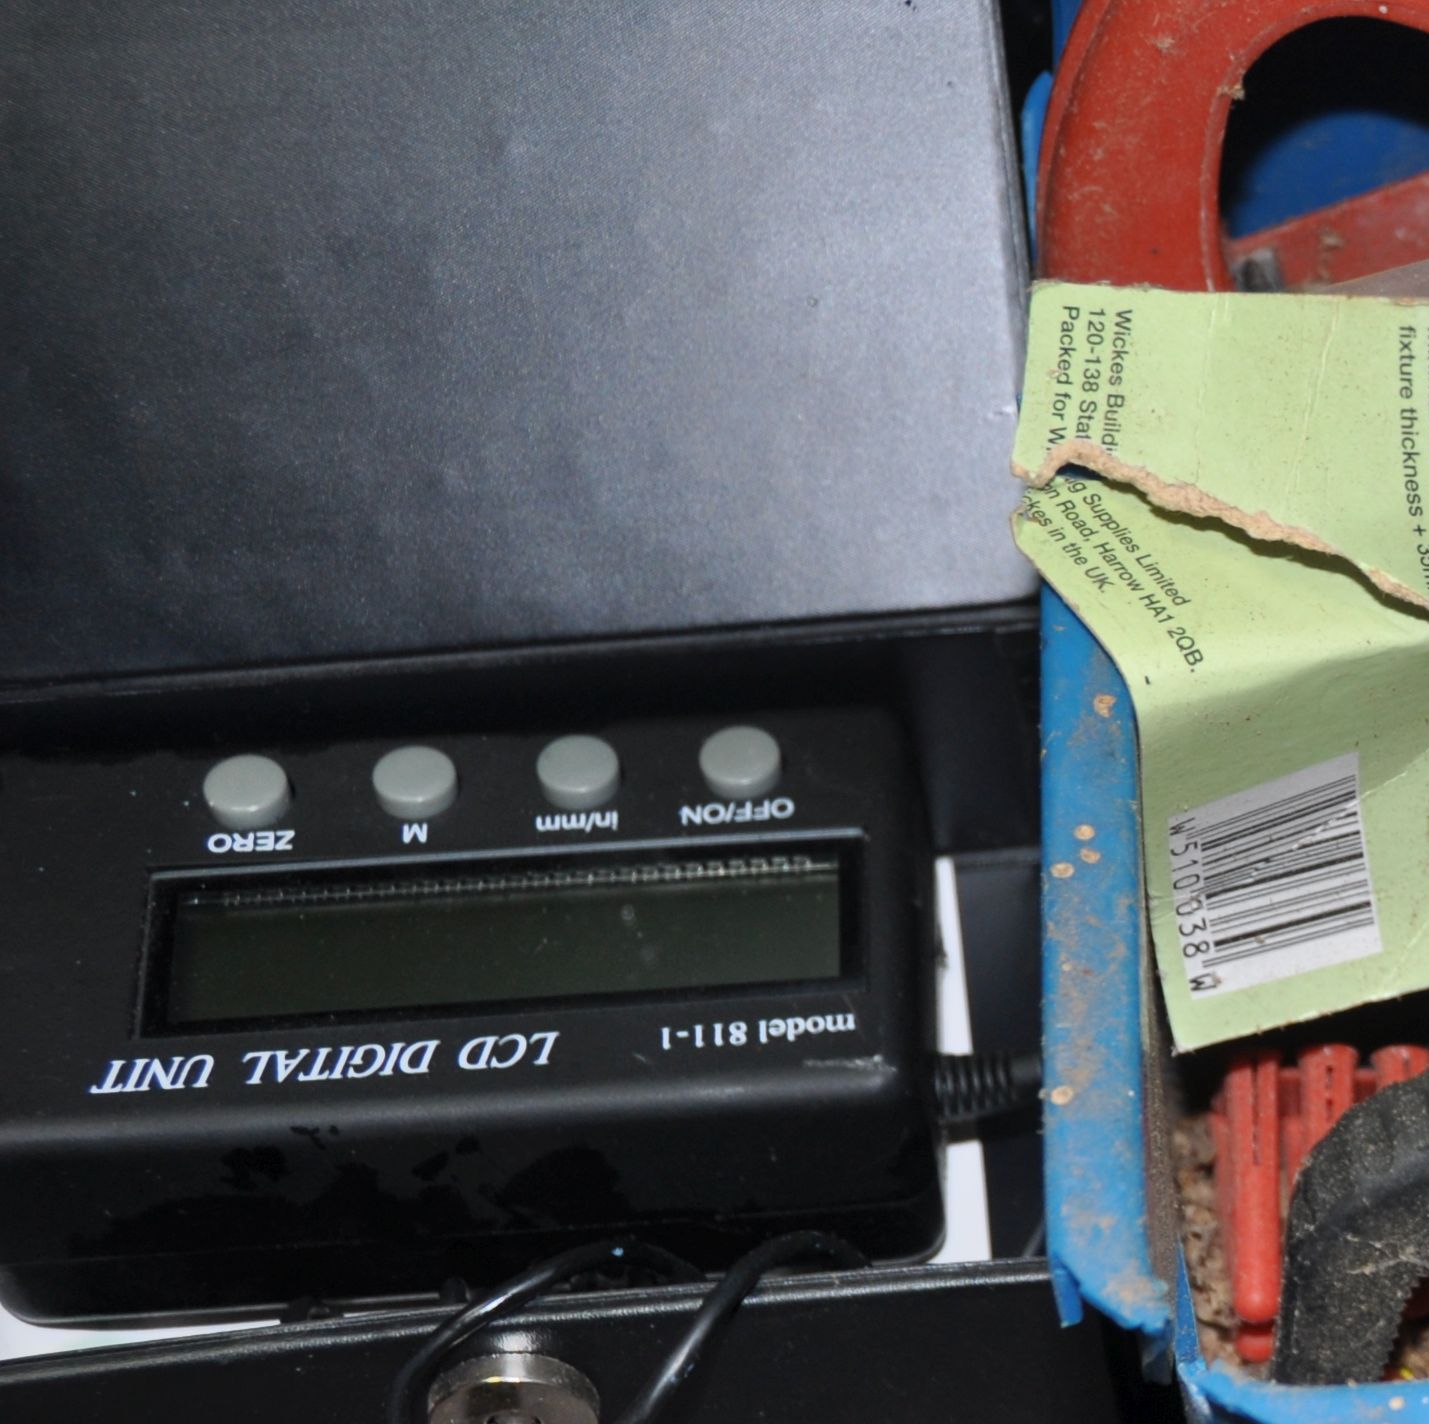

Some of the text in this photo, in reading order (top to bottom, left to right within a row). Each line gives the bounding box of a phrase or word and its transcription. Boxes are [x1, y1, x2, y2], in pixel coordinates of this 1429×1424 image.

[1043, 305, 1081, 455] Packed for W
[1081, 308, 1104, 392] 120-138
[1100, 308, 1135, 457] Wickes Buildi
[1398, 325, 1416, 401] fixture
[1400, 407, 1425, 520] thickness
[1021, 489, 1115, 595] ckes in the UK.
[1081, 492, 1140, 557] Supplies
[1136, 549, 1191, 607] Limited
[1415, 523, 1428, 536] +
[1055, 499, 1099, 543] Road,
[1092, 541, 1145, 602] Harrow
[1139, 590, 1173, 626] HA1
[1167, 626, 1206, 673] 2QB.
[207, 830, 296, 853] ZERO
[402, 823, 428, 844] M
[535, 810, 619, 833] in/mm
[679, 798, 795, 827] OFF/ON
[88, 1031, 560, 1095] LCD DIGITAL UNIT
[660, 1013, 857, 1051] model 811-1
